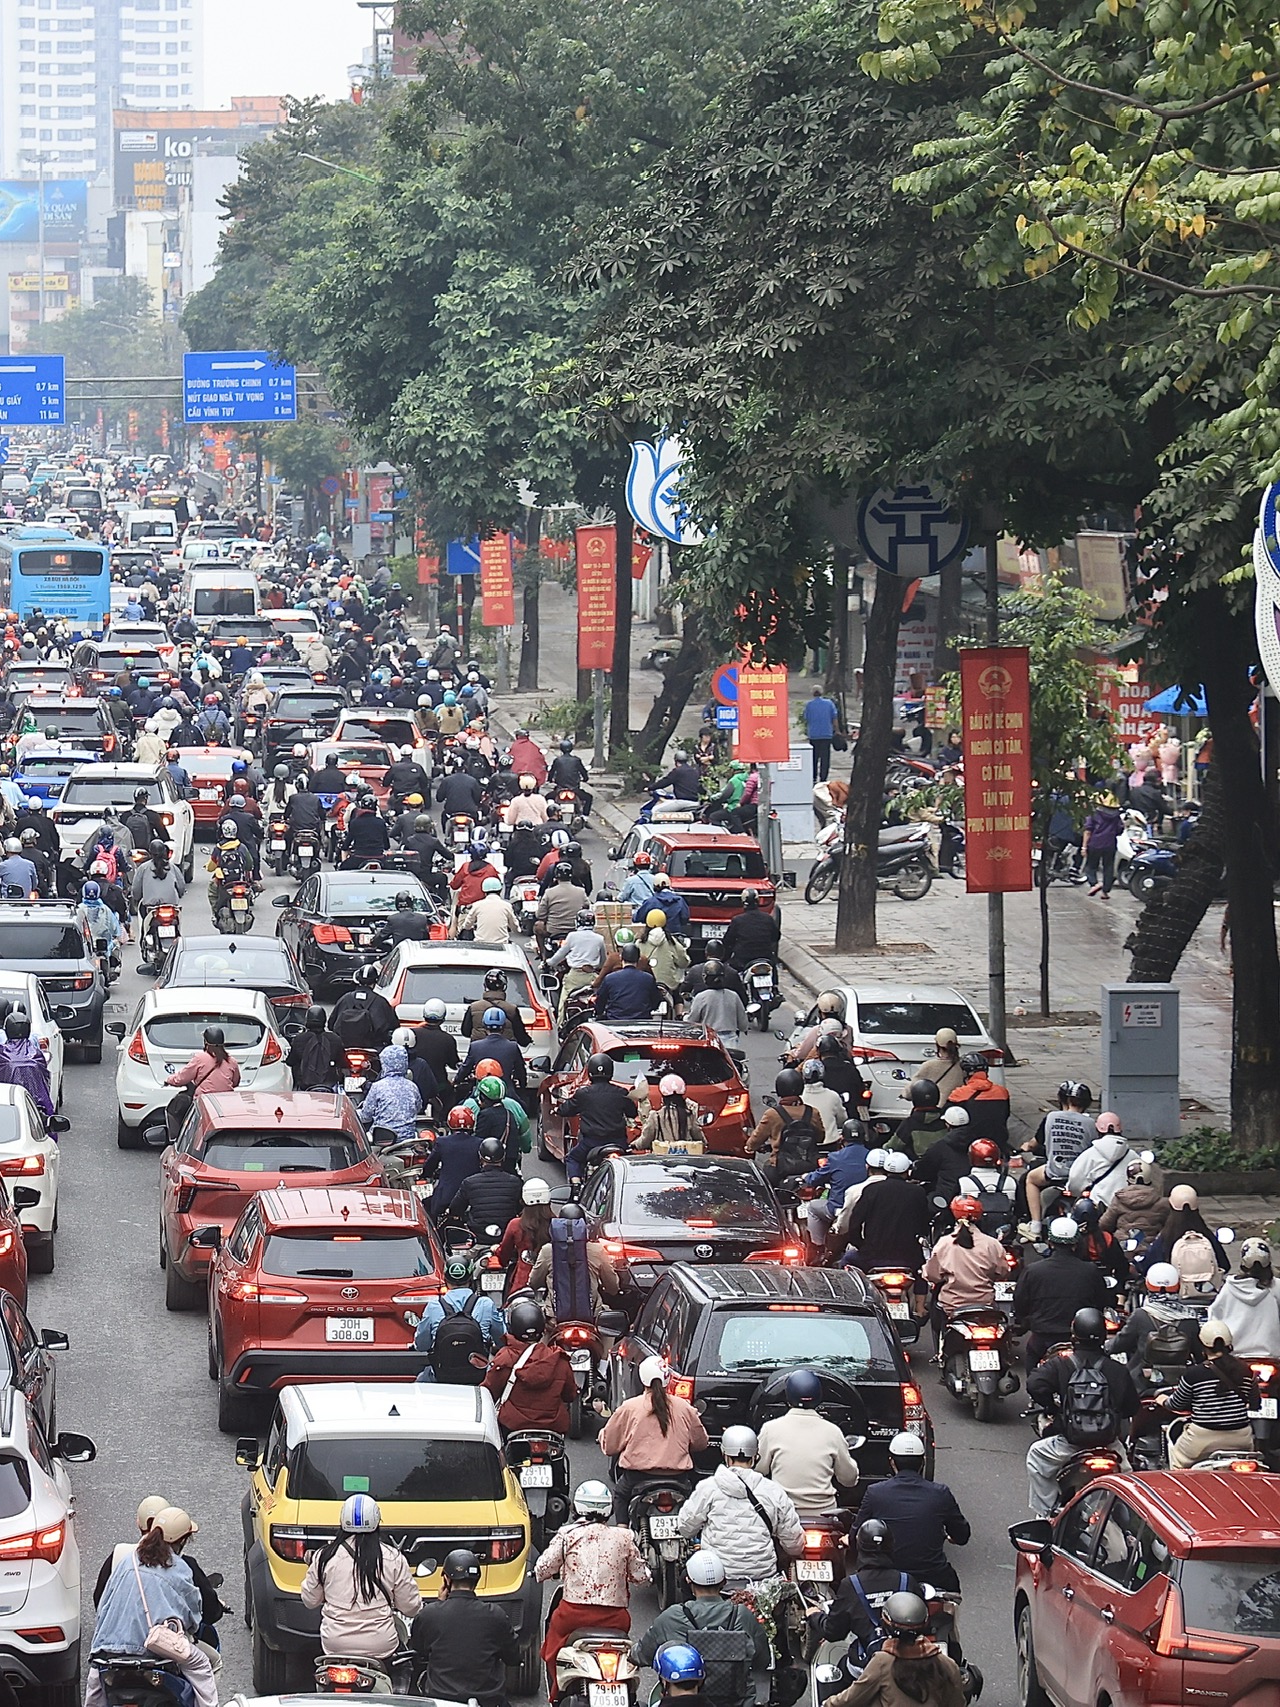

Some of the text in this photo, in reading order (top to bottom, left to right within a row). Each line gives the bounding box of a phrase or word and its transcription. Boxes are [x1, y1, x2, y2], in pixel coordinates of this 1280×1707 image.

[47, 382, 59, 391] km
[241, 378, 262, 387] CHINH
[280, 378, 292, 387] km
[6, 394, 22, 406] GIẤY
[41, 396, 46, 405] 5
[48, 396, 59, 405] km
[187, 391, 200, 403] NÚT
[202, 393, 218, 403] GIAO
[274, 392, 278, 401] 3
[280, 391, 292, 400] km
[39, 410, 47, 420] 11
[48, 410, 60, 419] km
[274, 406, 279, 415] 8
[281, 406, 292, 415] km
[1119, 685, 1150, 698] HOA
[340, 1319, 361, 1329] 30H
[332, 1330, 369, 1341] 308.09
